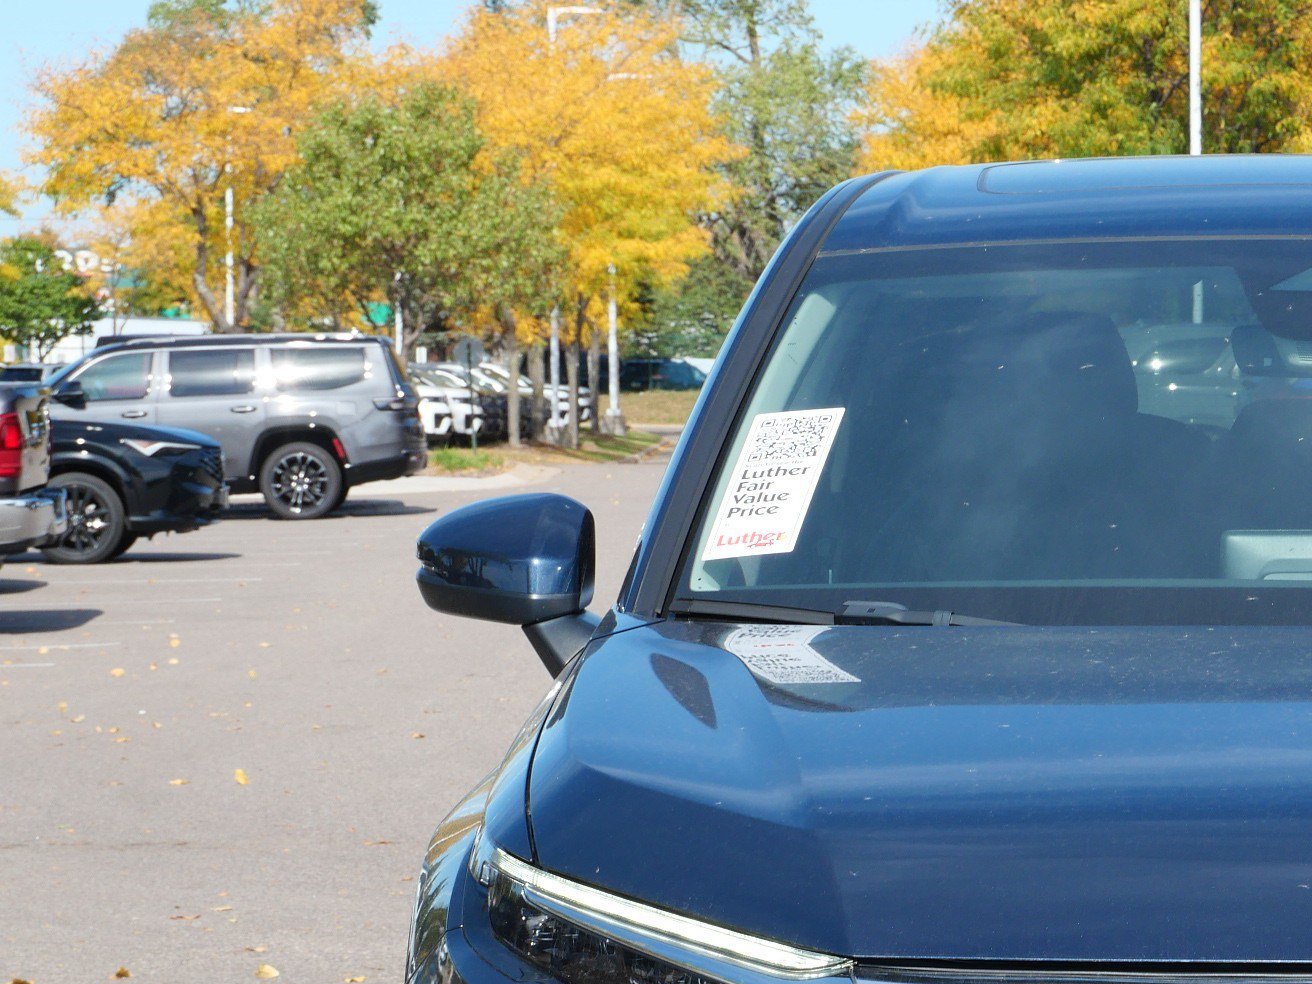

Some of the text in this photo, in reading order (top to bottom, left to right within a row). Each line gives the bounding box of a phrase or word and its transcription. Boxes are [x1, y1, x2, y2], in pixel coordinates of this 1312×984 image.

[742, 466, 811, 480] Luther
[736, 479, 775, 492] Fair
[733, 492, 790, 504] Value
[727, 504, 779, 518] Price
[717, 531, 785, 547] Luther
